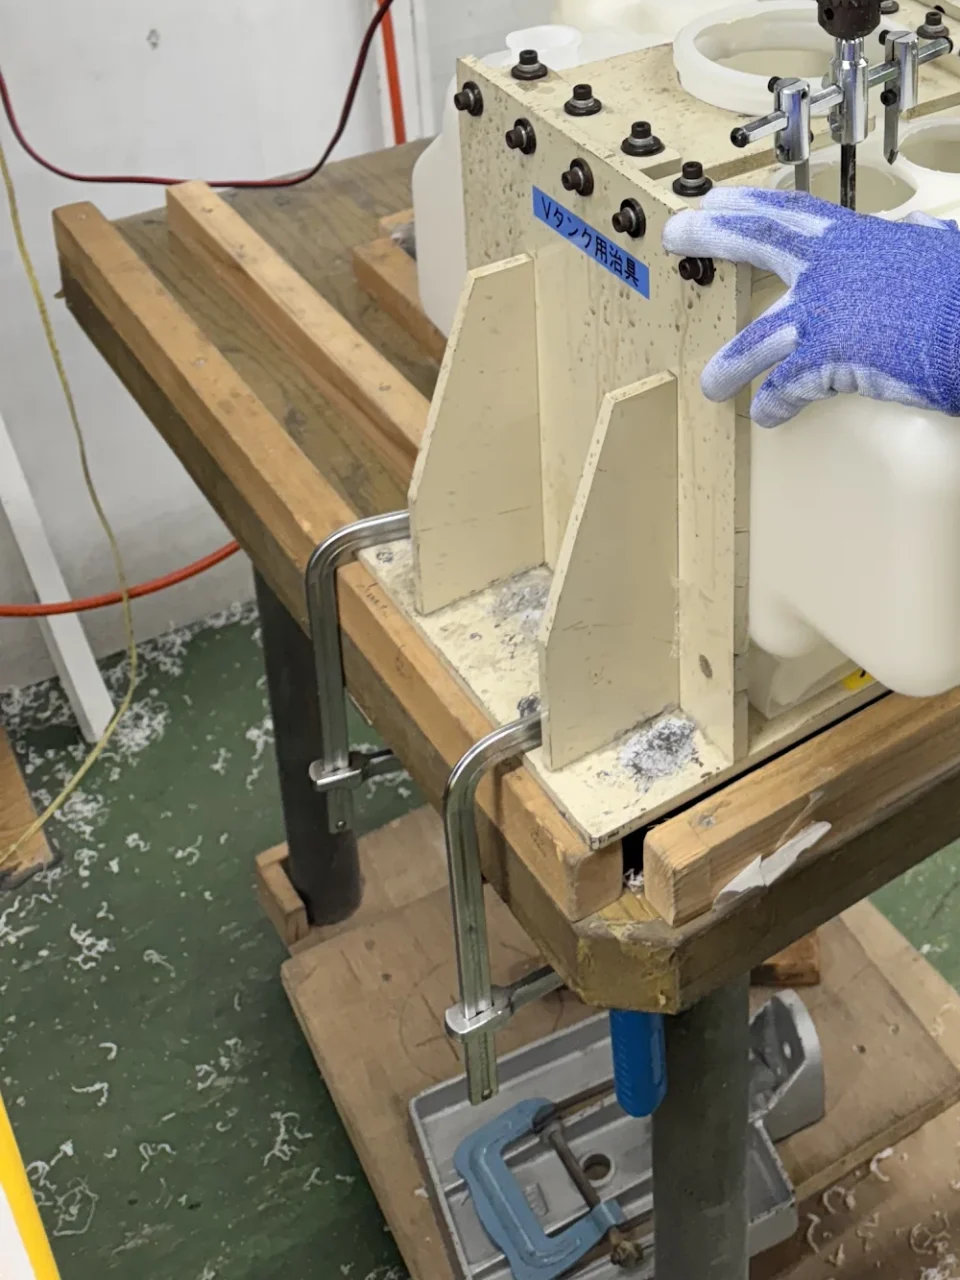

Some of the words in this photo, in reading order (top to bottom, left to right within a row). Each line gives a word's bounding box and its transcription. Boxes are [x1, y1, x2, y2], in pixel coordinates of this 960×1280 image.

[541, 196, 639, 288] Vタンク用治具
